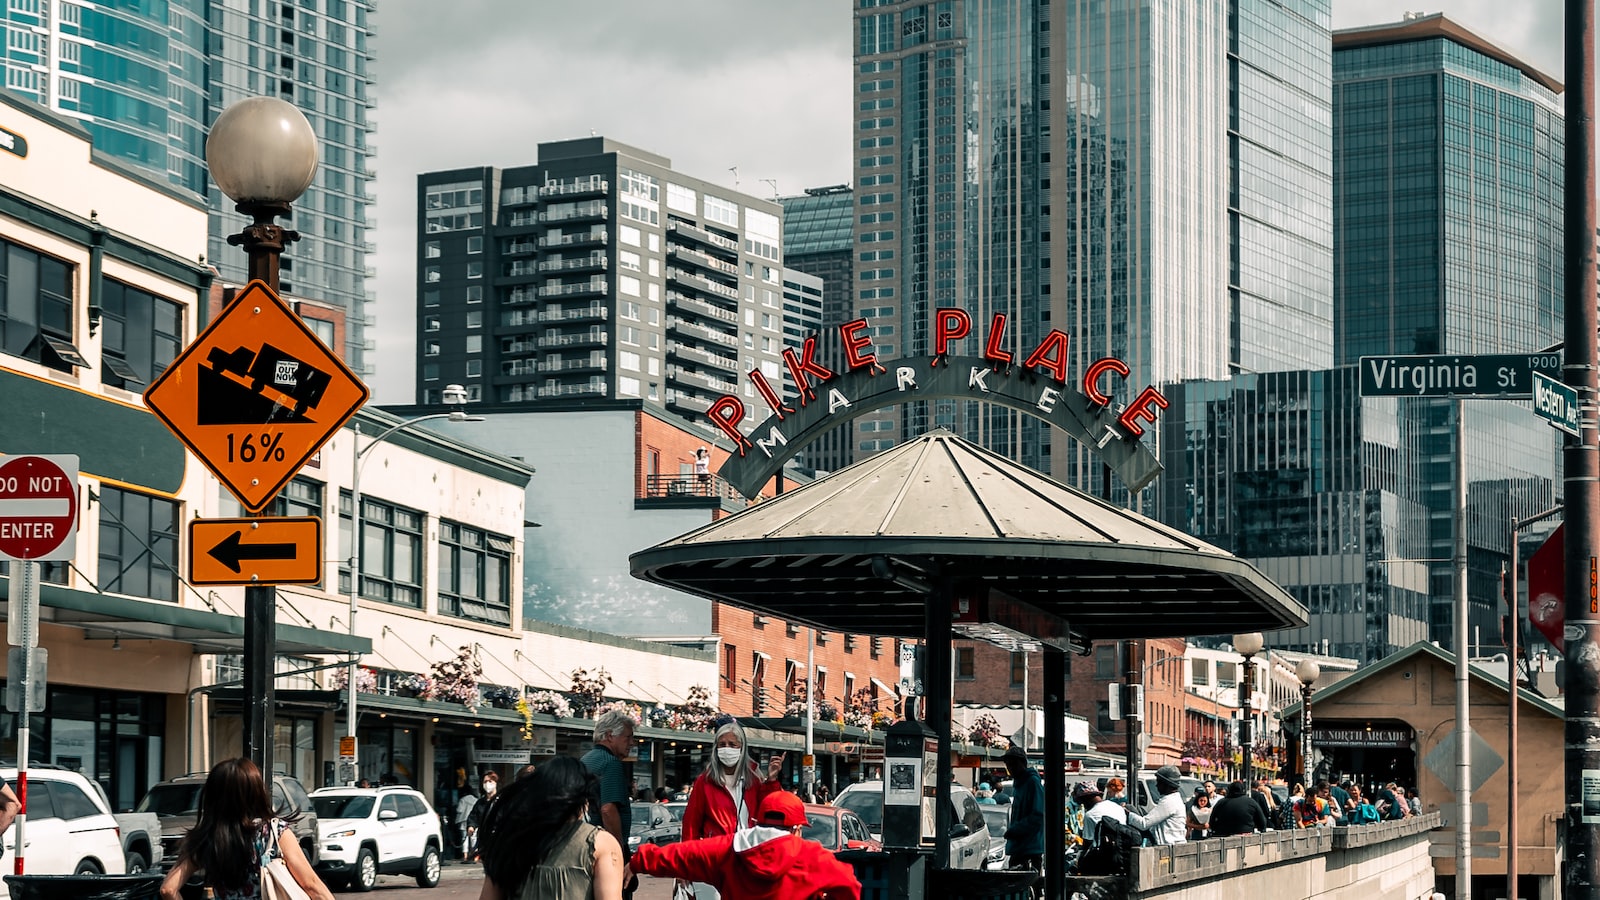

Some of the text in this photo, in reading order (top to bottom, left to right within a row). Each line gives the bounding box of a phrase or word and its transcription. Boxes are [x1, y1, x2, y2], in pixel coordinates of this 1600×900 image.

[279, 366, 296, 374] OUT
[1527, 356, 1558, 369] 1900
[706, 307, 1170, 444] PIKE PLACE
[1370, 358, 1517, 395] Virginia St
[1535, 377, 1564, 418] Western
[756, 366, 1122, 458] MARKET
[226, 432, 285, 463] 16%
[29, 476, 63, 493] NOT
[1, 523, 54, 539] ENTER
[1312, 730, 1406, 741] HE NORTH ARCADE
